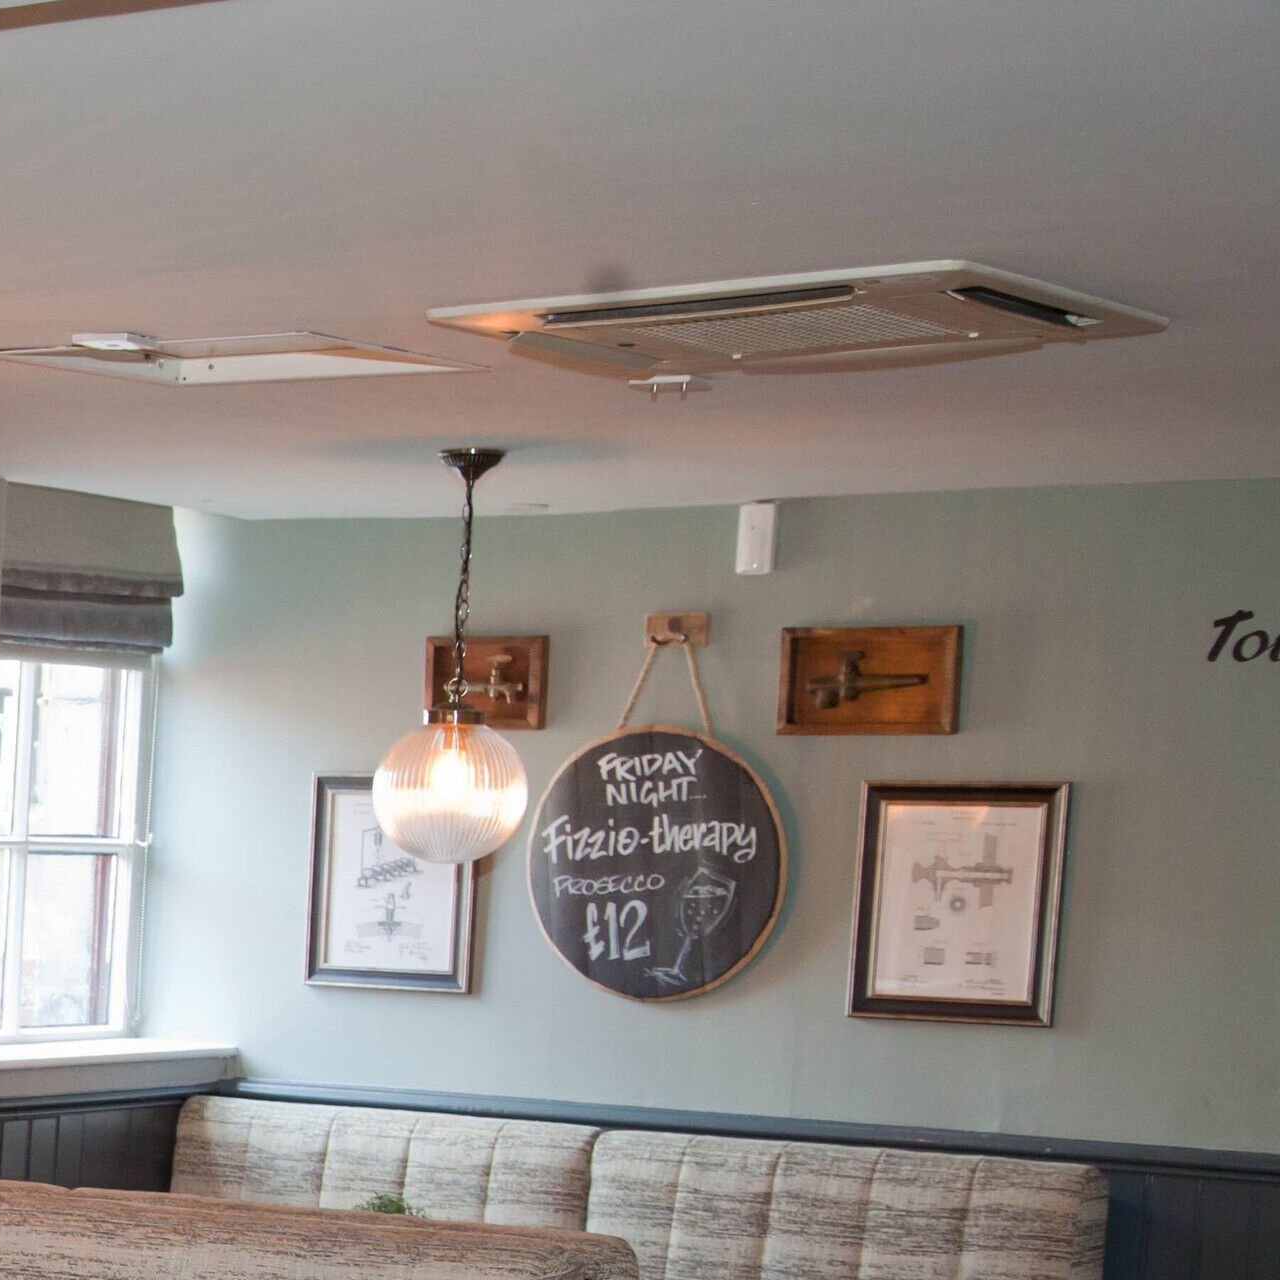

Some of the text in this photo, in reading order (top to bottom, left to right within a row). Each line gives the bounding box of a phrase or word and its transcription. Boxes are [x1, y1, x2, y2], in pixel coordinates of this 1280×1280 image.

[597, 748, 704, 781] FRIDAY
[541, 813, 758, 864] Fizzio-therapy
[553, 873, 666, 898] PROSECCO
[583, 900, 652, 962] £12
